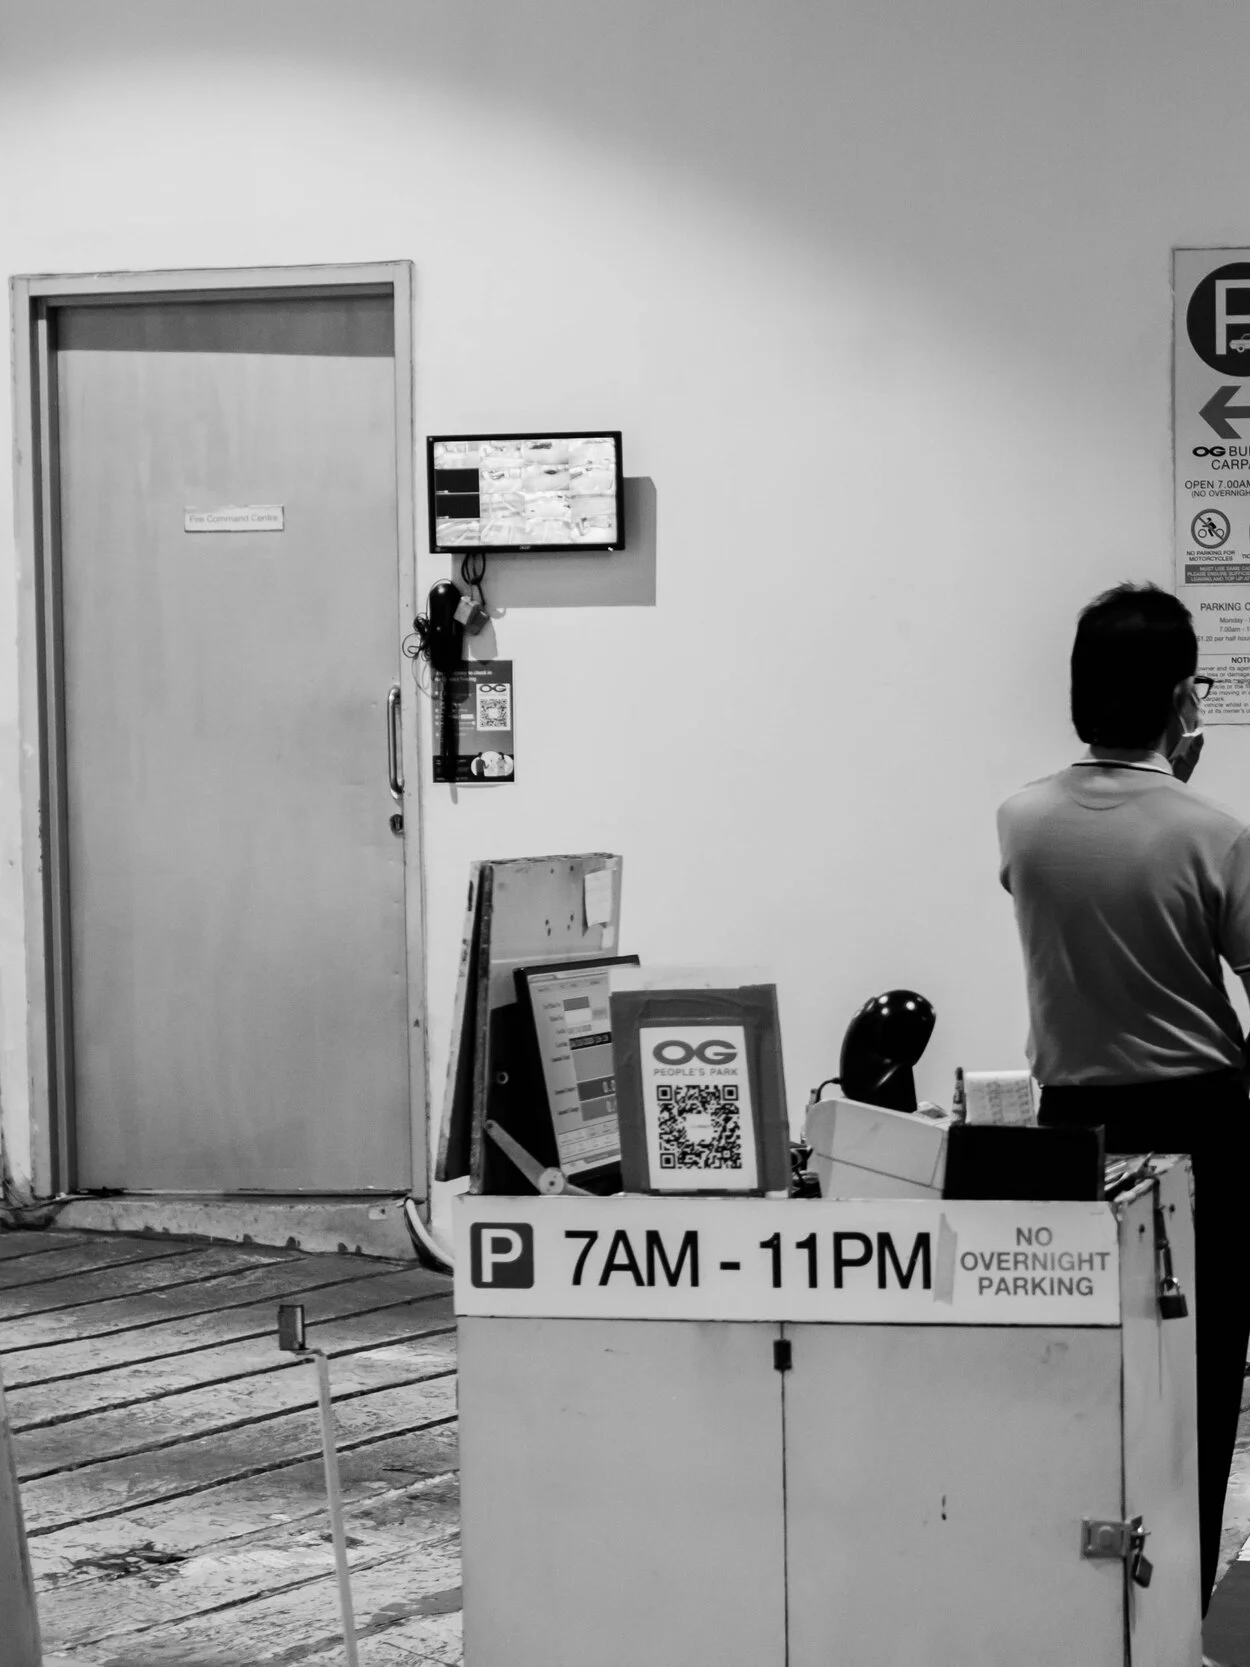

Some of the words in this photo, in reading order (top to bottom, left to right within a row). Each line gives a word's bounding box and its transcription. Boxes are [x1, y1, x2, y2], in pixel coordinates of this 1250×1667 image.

[1192, 446, 1226, 457] OG
[1184, 480, 1214, 489] OPEN
[1191, 490, 1206, 498] (NO
[1200, 603, 1241, 611] PARKING
[653, 1039, 738, 1066] OG
[653, 1068, 705, 1076] PEOPLE'S
[709, 1068, 738, 1076] PARK
[1015, 1226, 1053, 1246] NO
[481, 1228, 523, 1283] P
[564, 1230, 699, 1287] 7AM
[759, 1231, 932, 1289] 11PM
[960, 1252, 1111, 1272] OVERNIGHT
[978, 1276, 1094, 1296] PARKING
